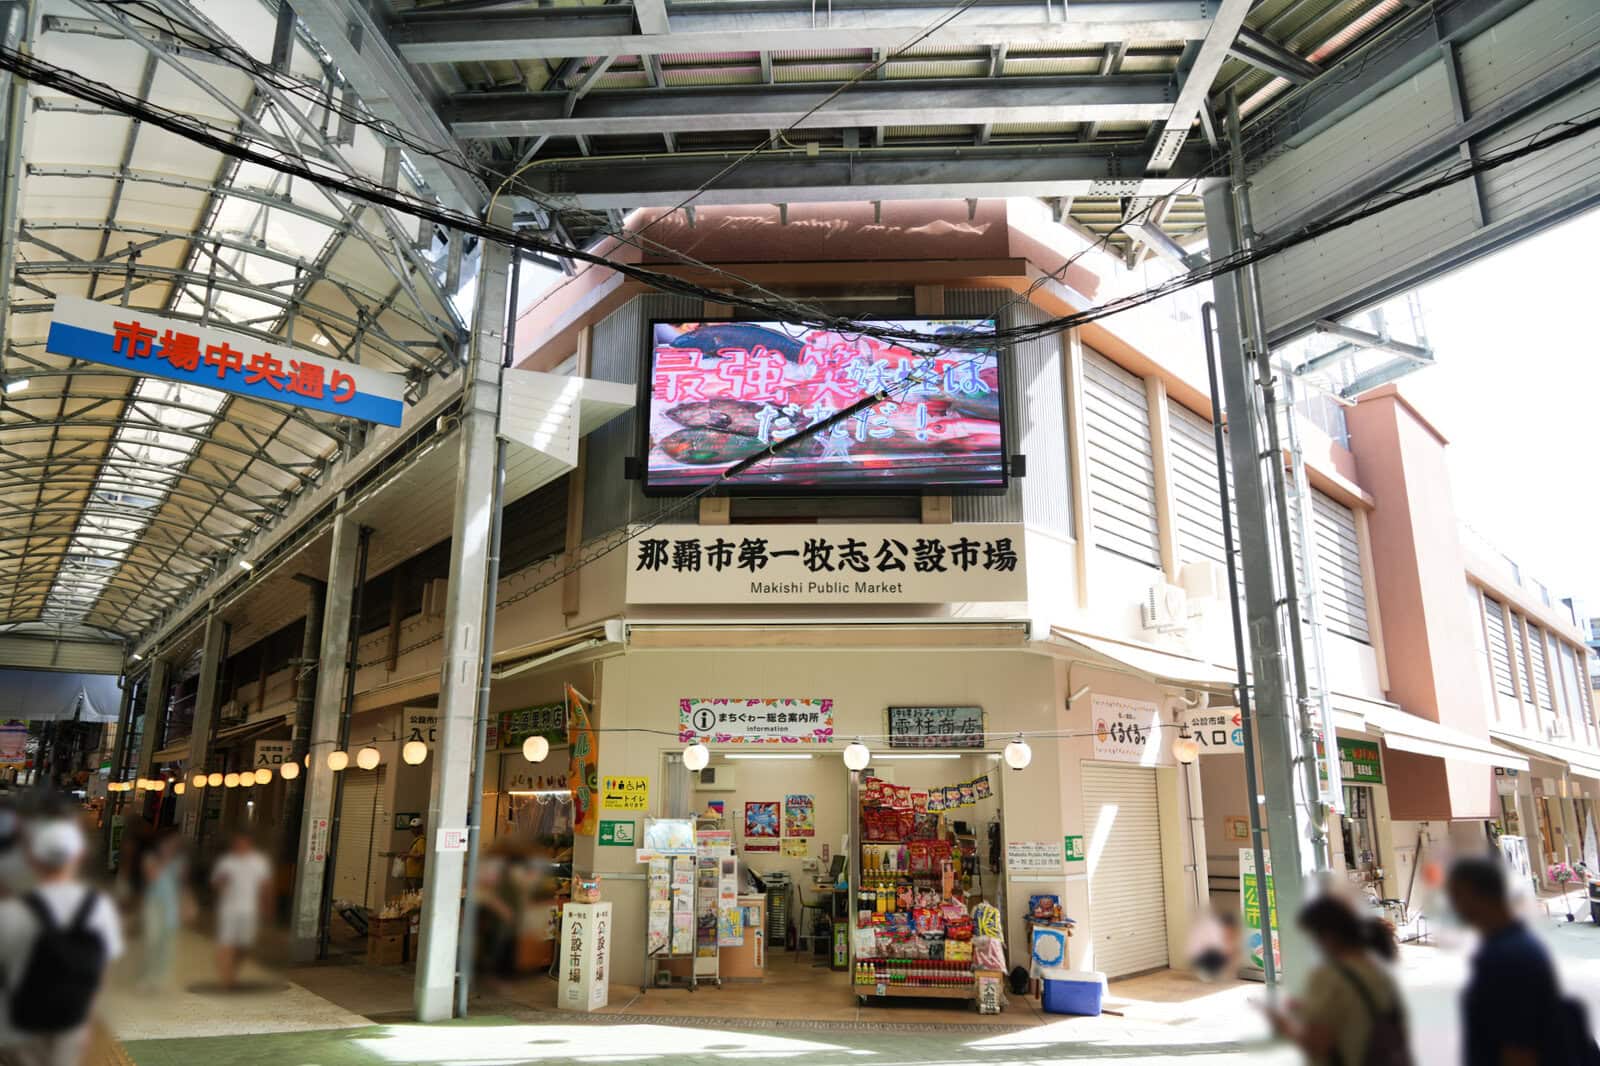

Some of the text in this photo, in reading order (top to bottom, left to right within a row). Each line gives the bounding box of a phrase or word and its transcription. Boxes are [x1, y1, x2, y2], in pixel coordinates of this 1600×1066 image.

[112, 320, 357, 403] 市場中央通り
[636, 537, 1018, 573] 那覇市第一牧志公設市場
[751, 581, 903, 594] Makishi Public Market
[1192, 715, 1226, 726] 公設市場
[746, 725, 789, 733] information
[1194, 730, 1226, 746] 入口
[258, 754, 282, 764] 入口
[568, 921, 583, 983] 公設市場
